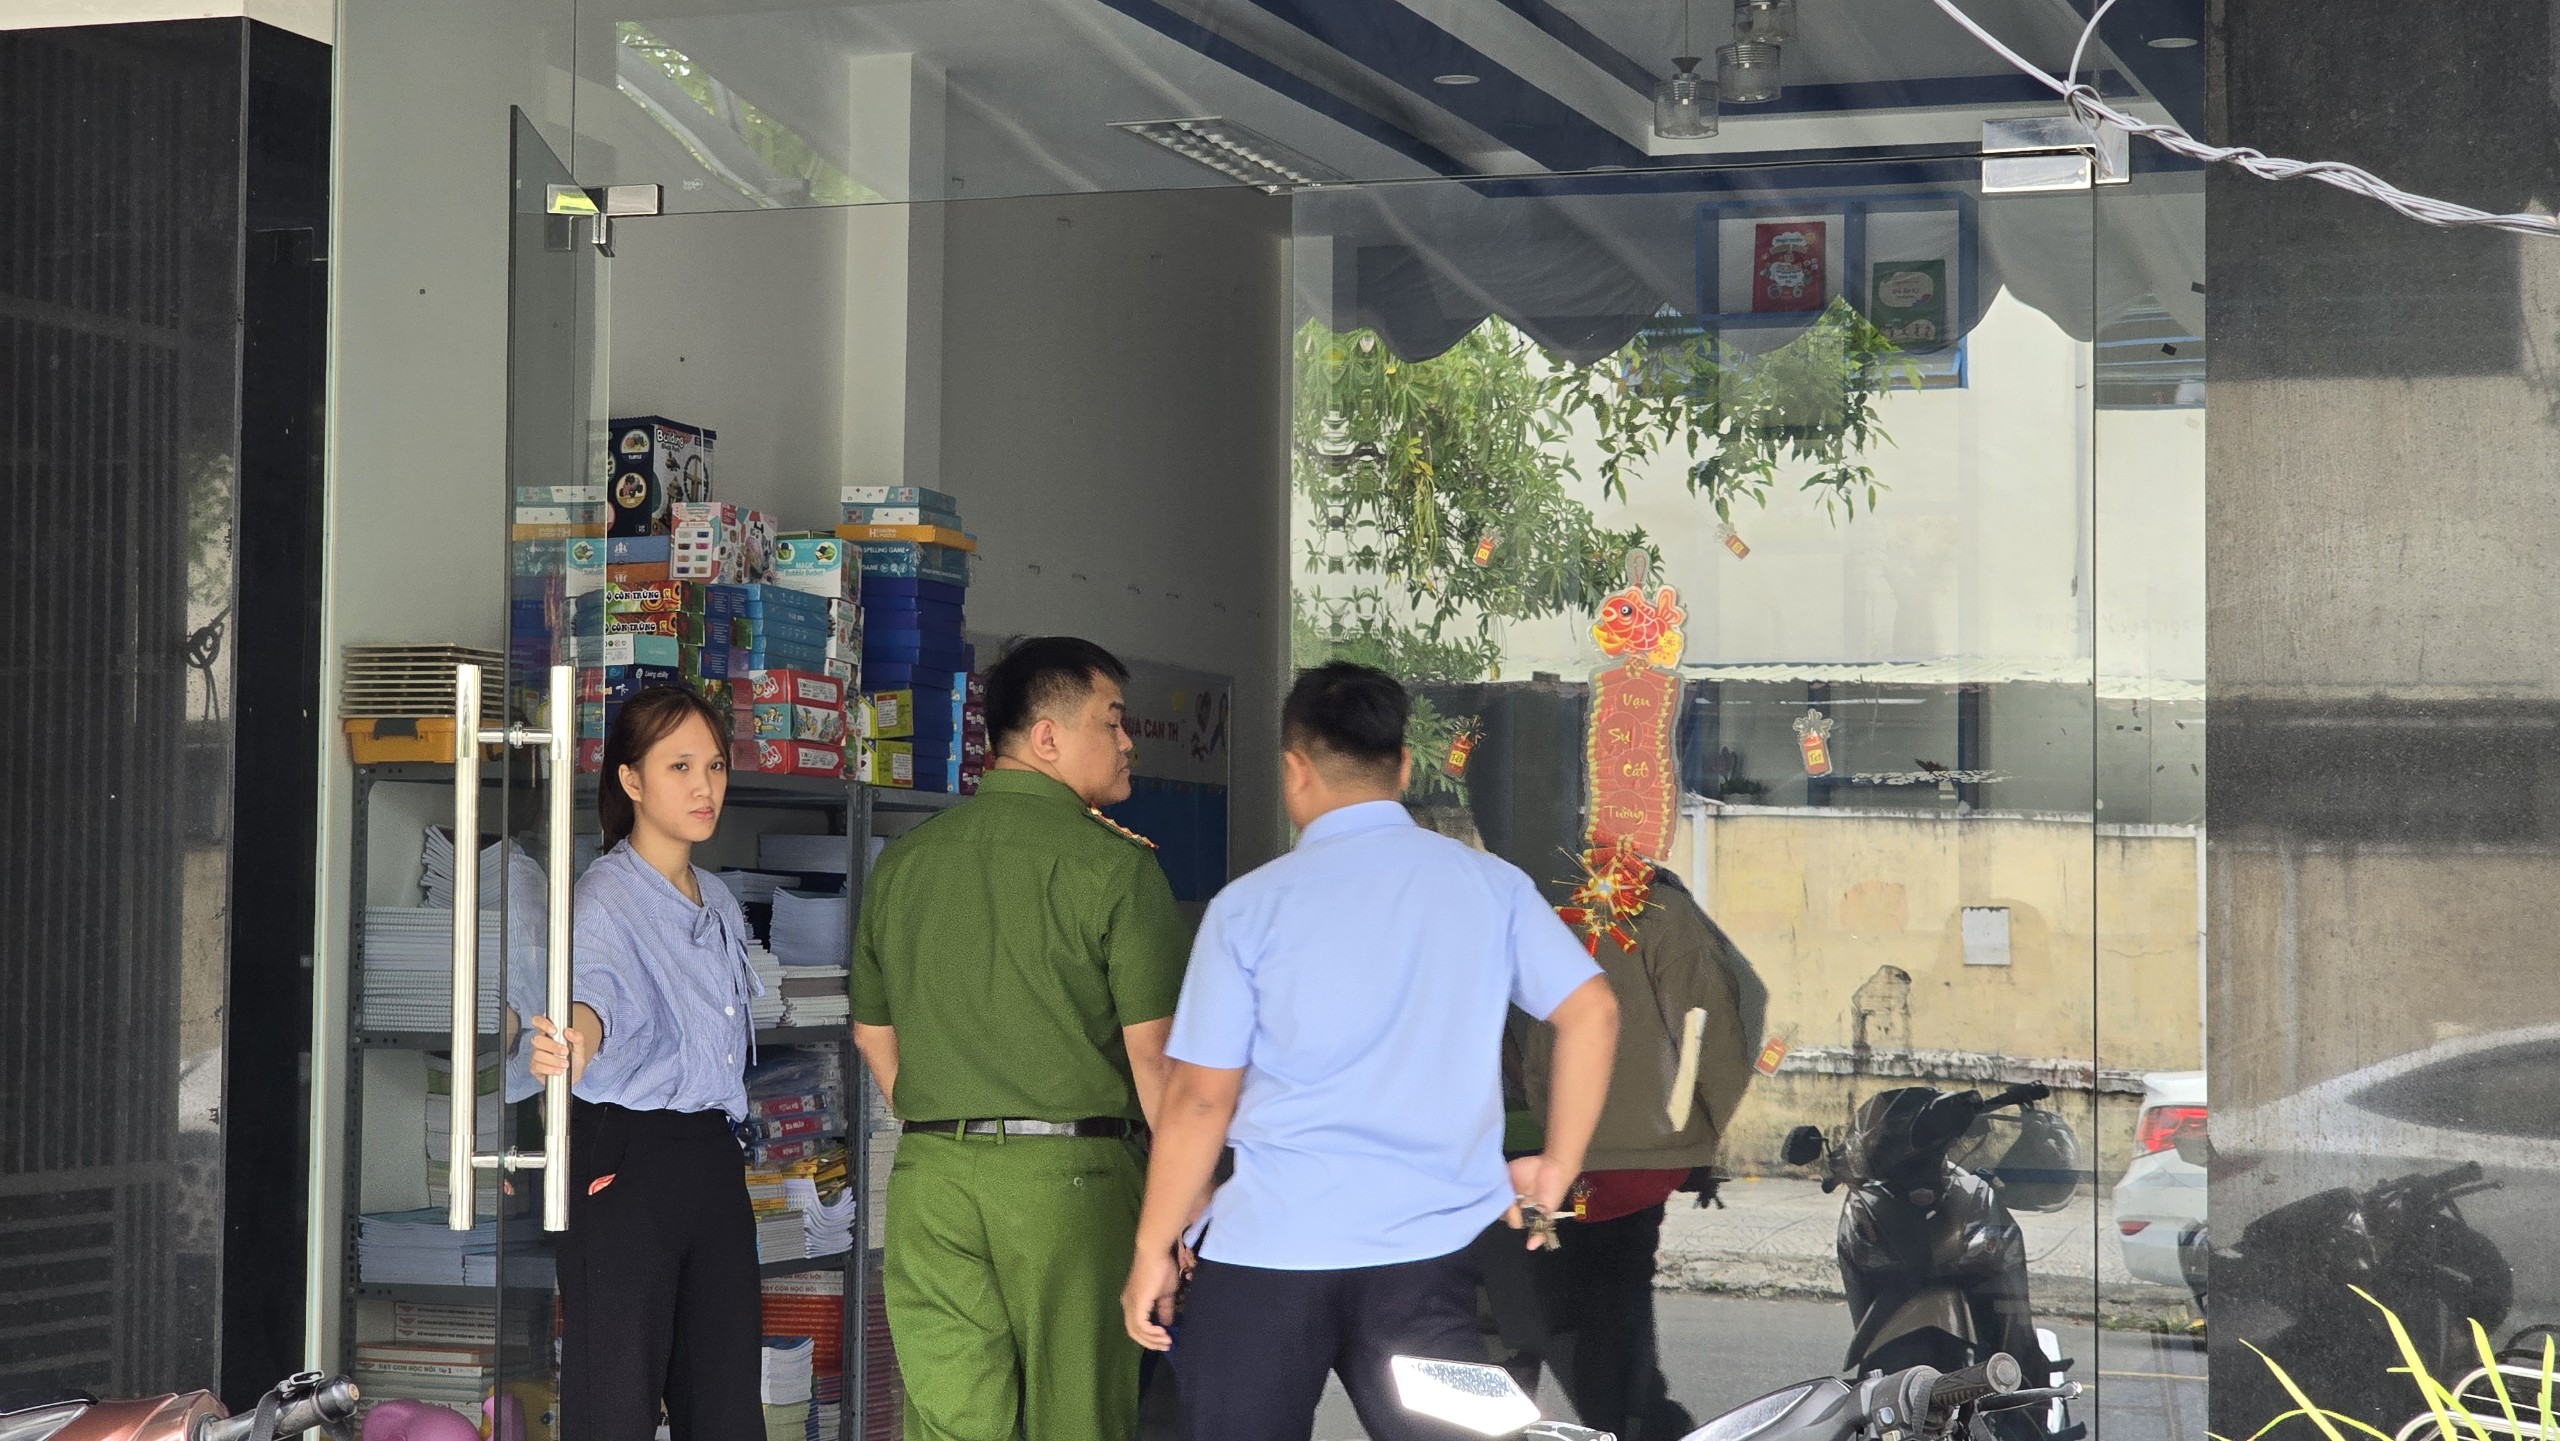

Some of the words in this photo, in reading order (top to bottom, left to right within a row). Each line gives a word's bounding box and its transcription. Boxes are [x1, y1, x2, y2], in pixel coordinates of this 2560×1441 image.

[657, 429, 685, 449] Building
[1622, 693, 1651, 709] Vạn
[1623, 760, 1649, 778] Cát
[1604, 805, 1645, 826] Tường
